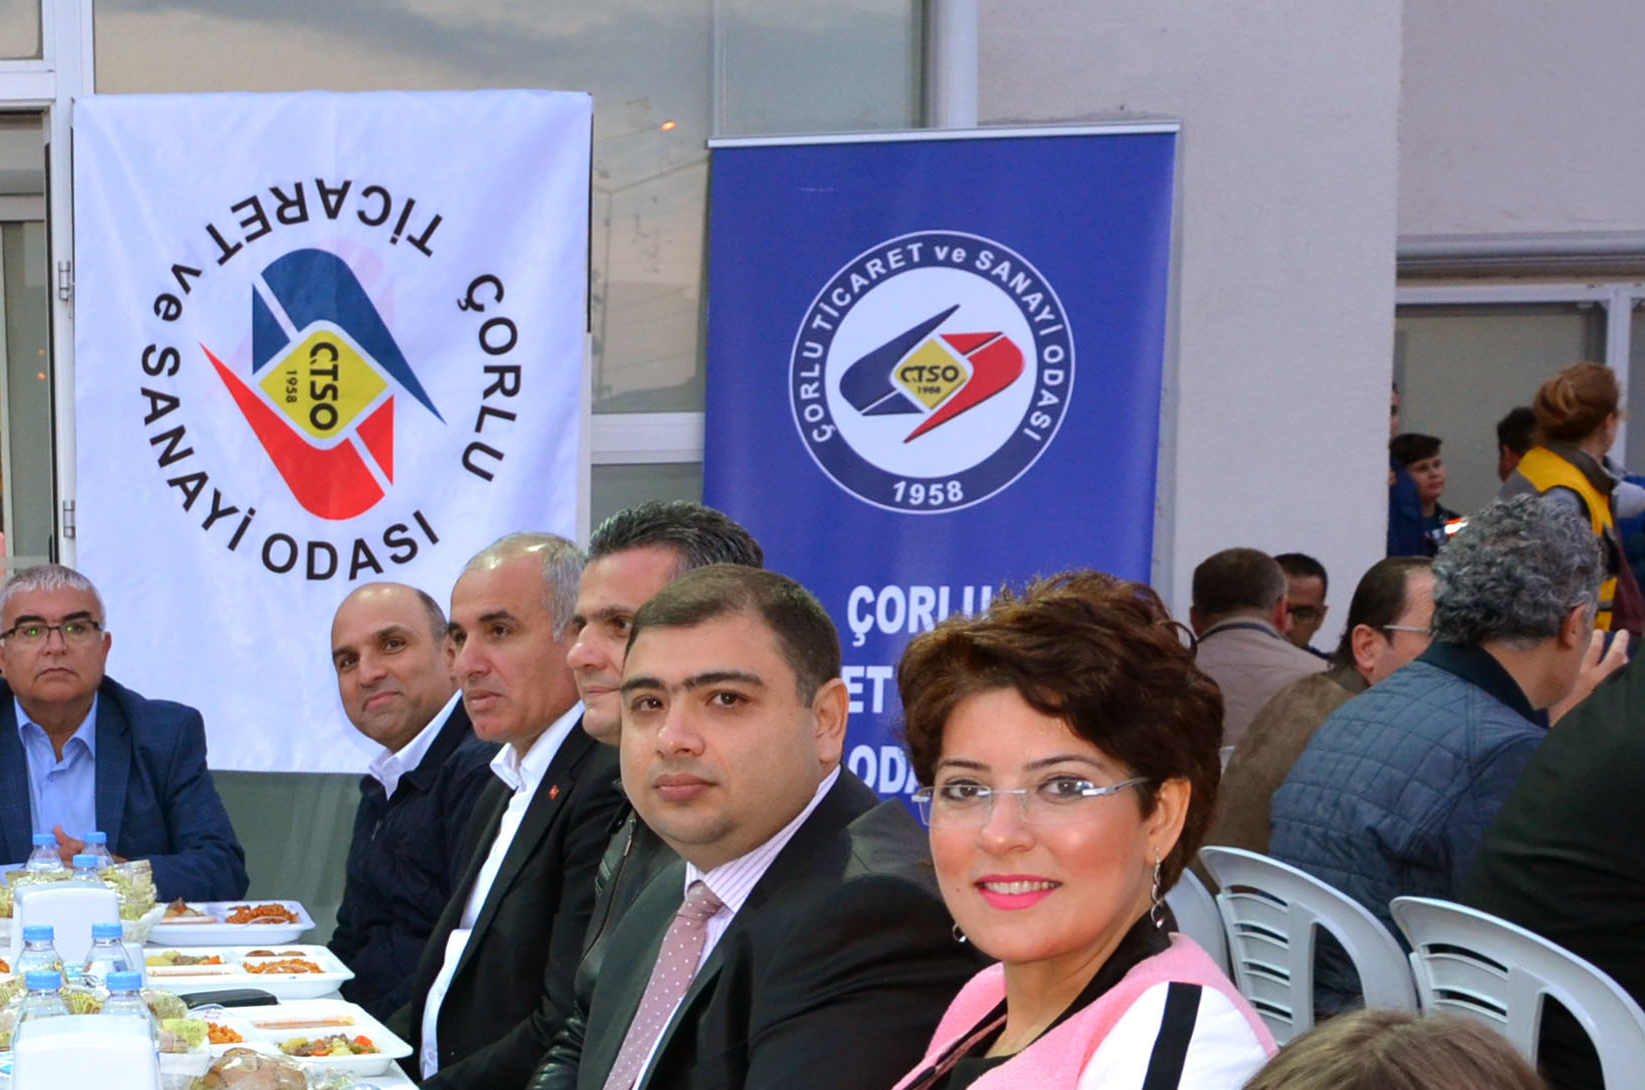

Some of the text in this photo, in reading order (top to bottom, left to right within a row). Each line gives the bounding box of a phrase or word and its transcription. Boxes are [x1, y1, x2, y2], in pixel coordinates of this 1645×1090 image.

[140, 178, 522, 581] ÇORLU TİCARET ve SANAYİ ODASI
[285, 369, 297, 404] 1958
[801, 242, 1064, 443] ÇORLU TİCARET ve SANAYİ ODASI
[892, 480, 964, 505] 1958
